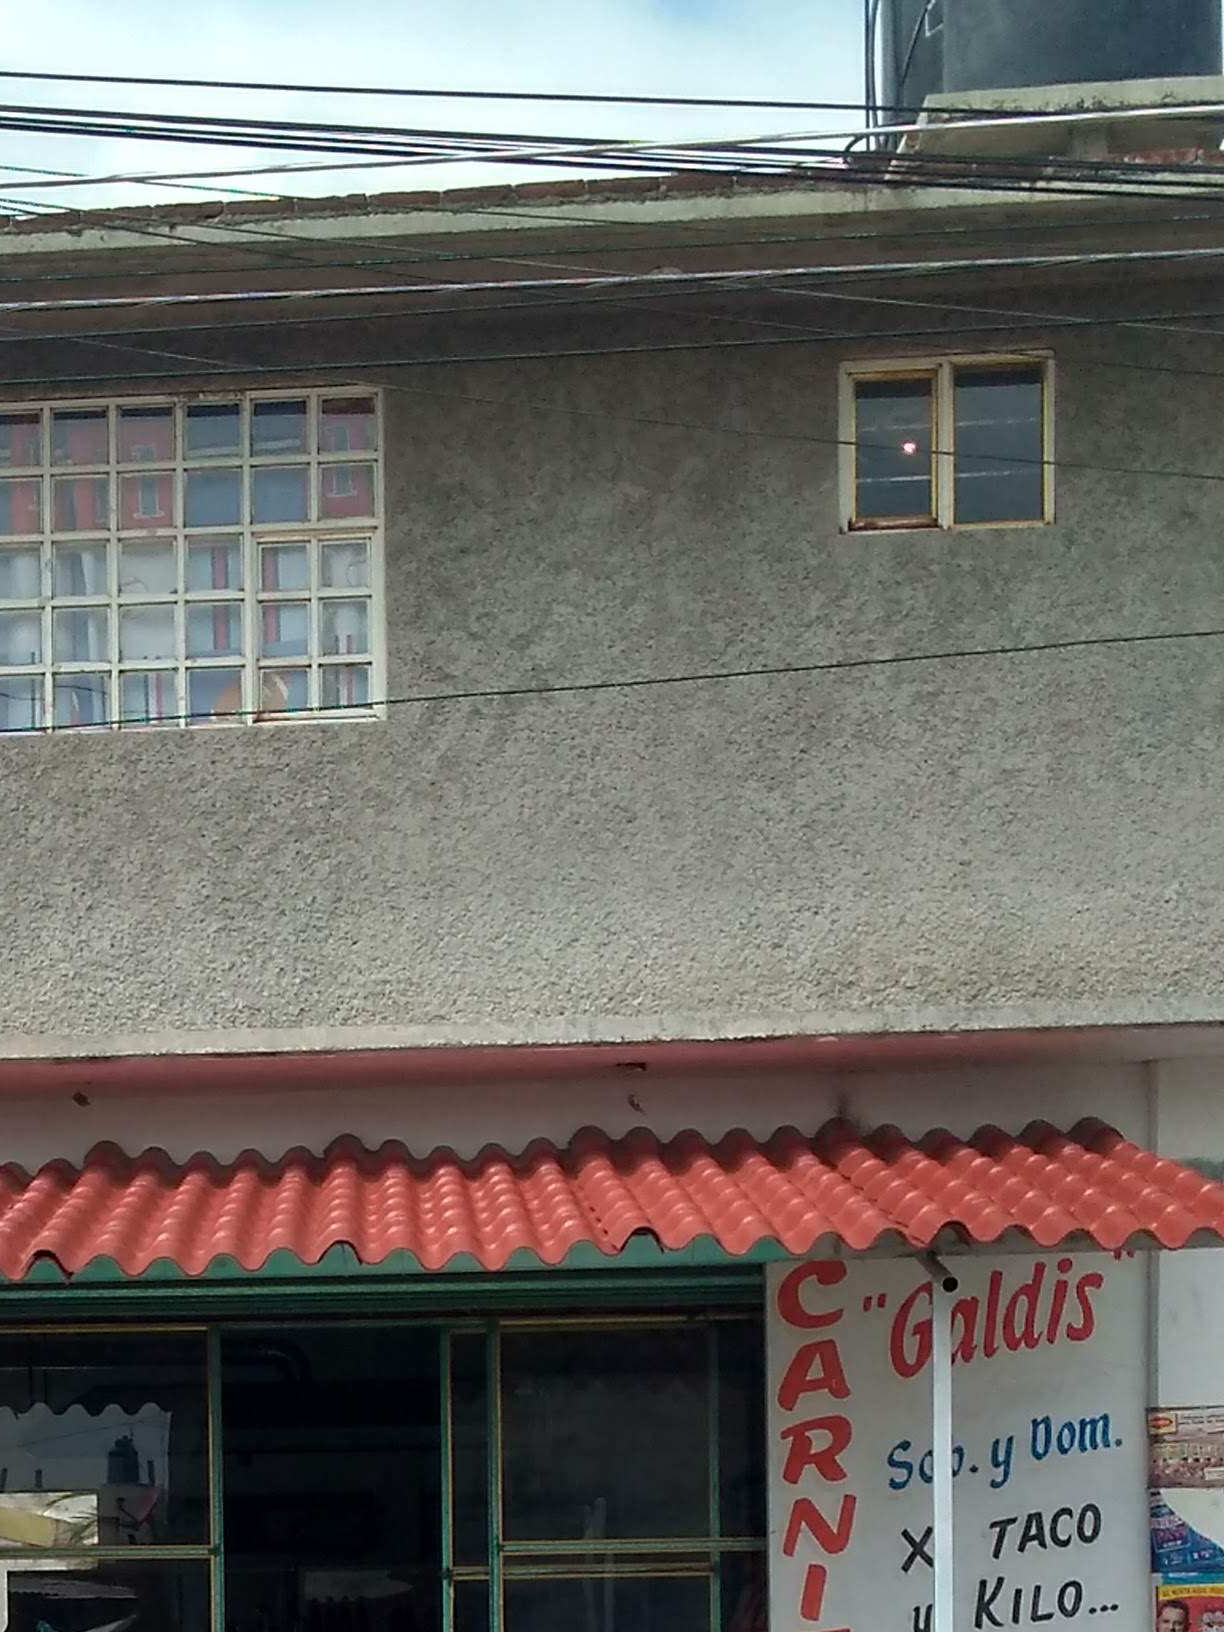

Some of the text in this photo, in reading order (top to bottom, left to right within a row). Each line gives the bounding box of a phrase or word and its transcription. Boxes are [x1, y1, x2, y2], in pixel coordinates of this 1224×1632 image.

[989, 1434, 1015, 1489] y
[1030, 1411, 1123, 1460] Dom.
[989, 1502, 1103, 1561] TACO
